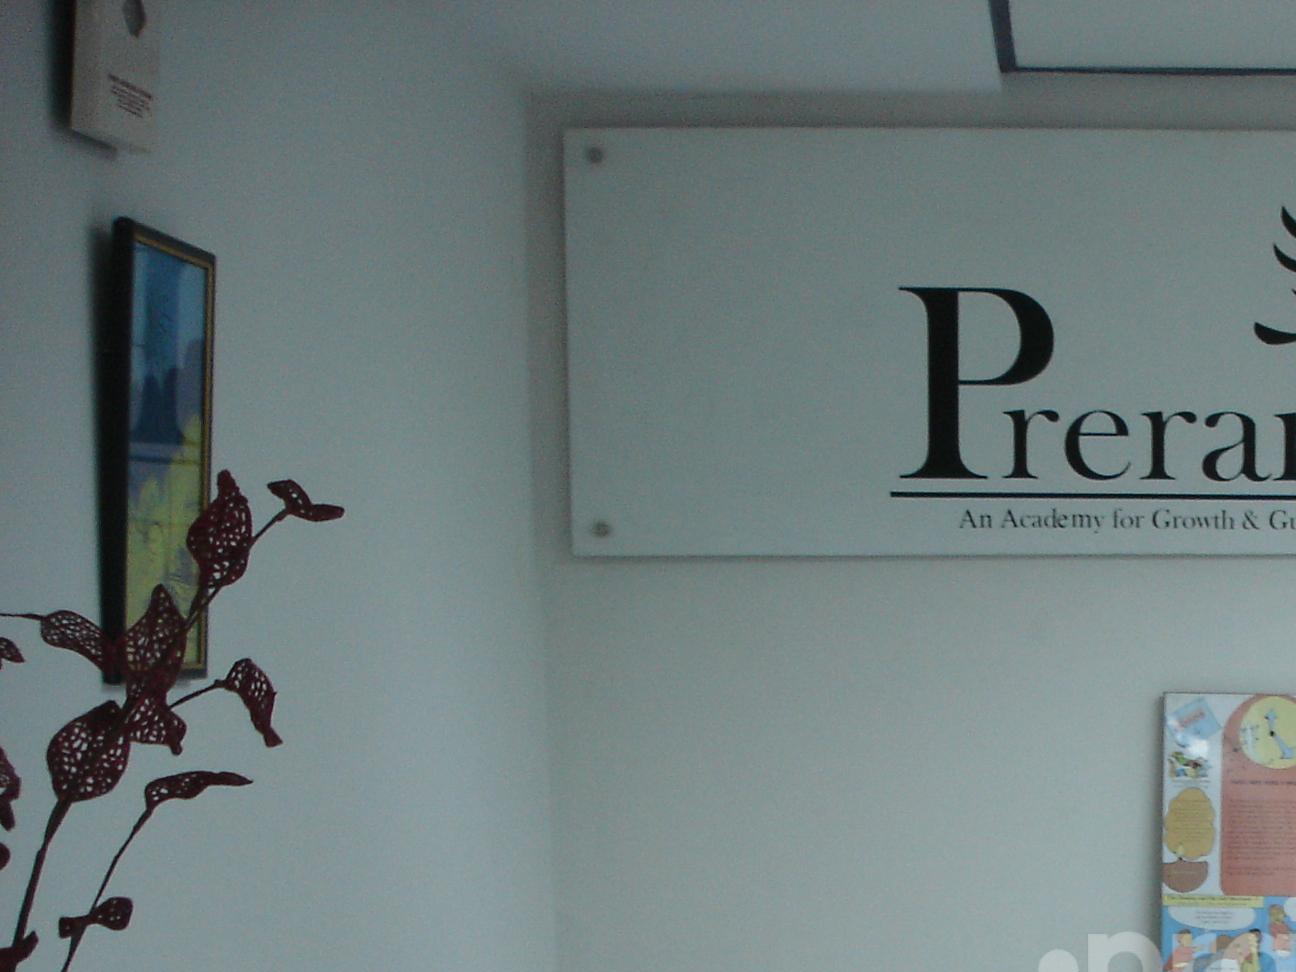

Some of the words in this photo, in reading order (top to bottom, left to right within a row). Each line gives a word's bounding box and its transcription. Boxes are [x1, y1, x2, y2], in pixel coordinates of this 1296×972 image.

[959, 510, 993, 530] An
[1001, 509, 1104, 534] Academy
[1113, 509, 1145, 530] for
[1151, 509, 1235, 531] Growth
[1241, 511, 1260, 530] &
